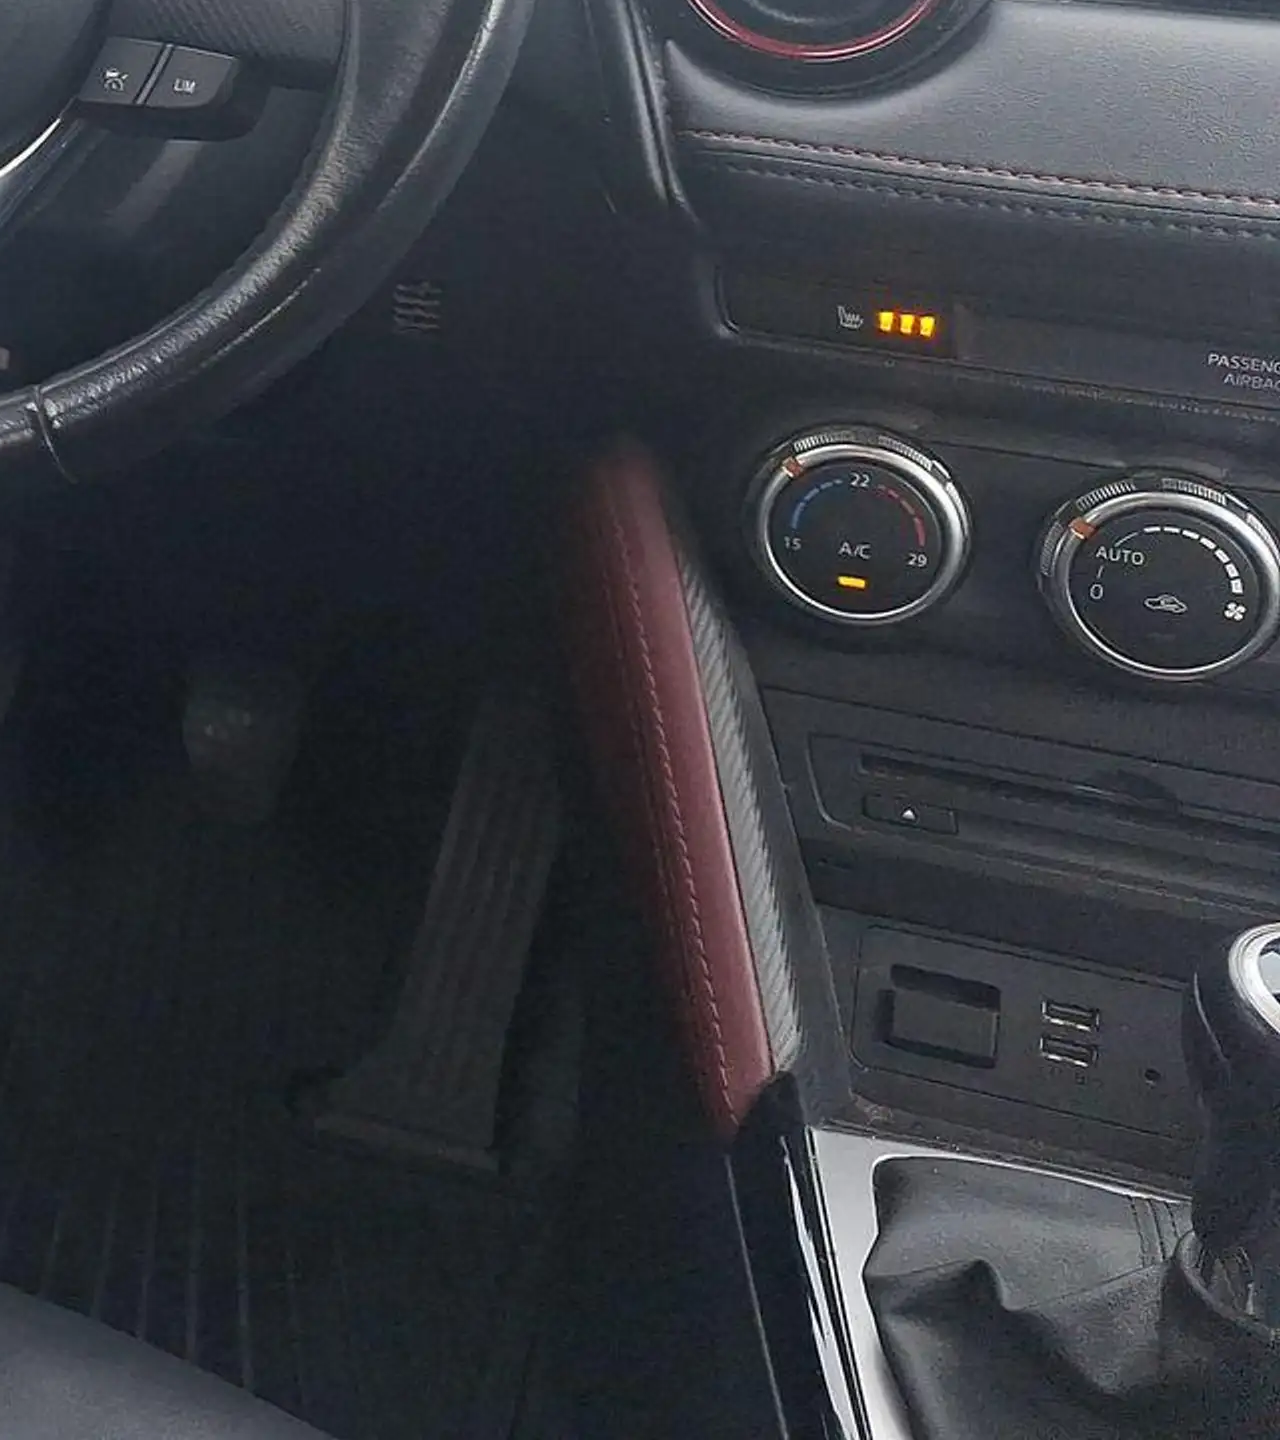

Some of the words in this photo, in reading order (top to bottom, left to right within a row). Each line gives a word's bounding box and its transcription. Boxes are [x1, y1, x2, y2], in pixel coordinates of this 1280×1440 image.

[850, 472, 871, 488] 22
[784, 535, 802, 551] 15
[838, 541, 872, 560] A/C
[907, 553, 928, 568] 29
[1096, 545, 1145, 566] AUTO
